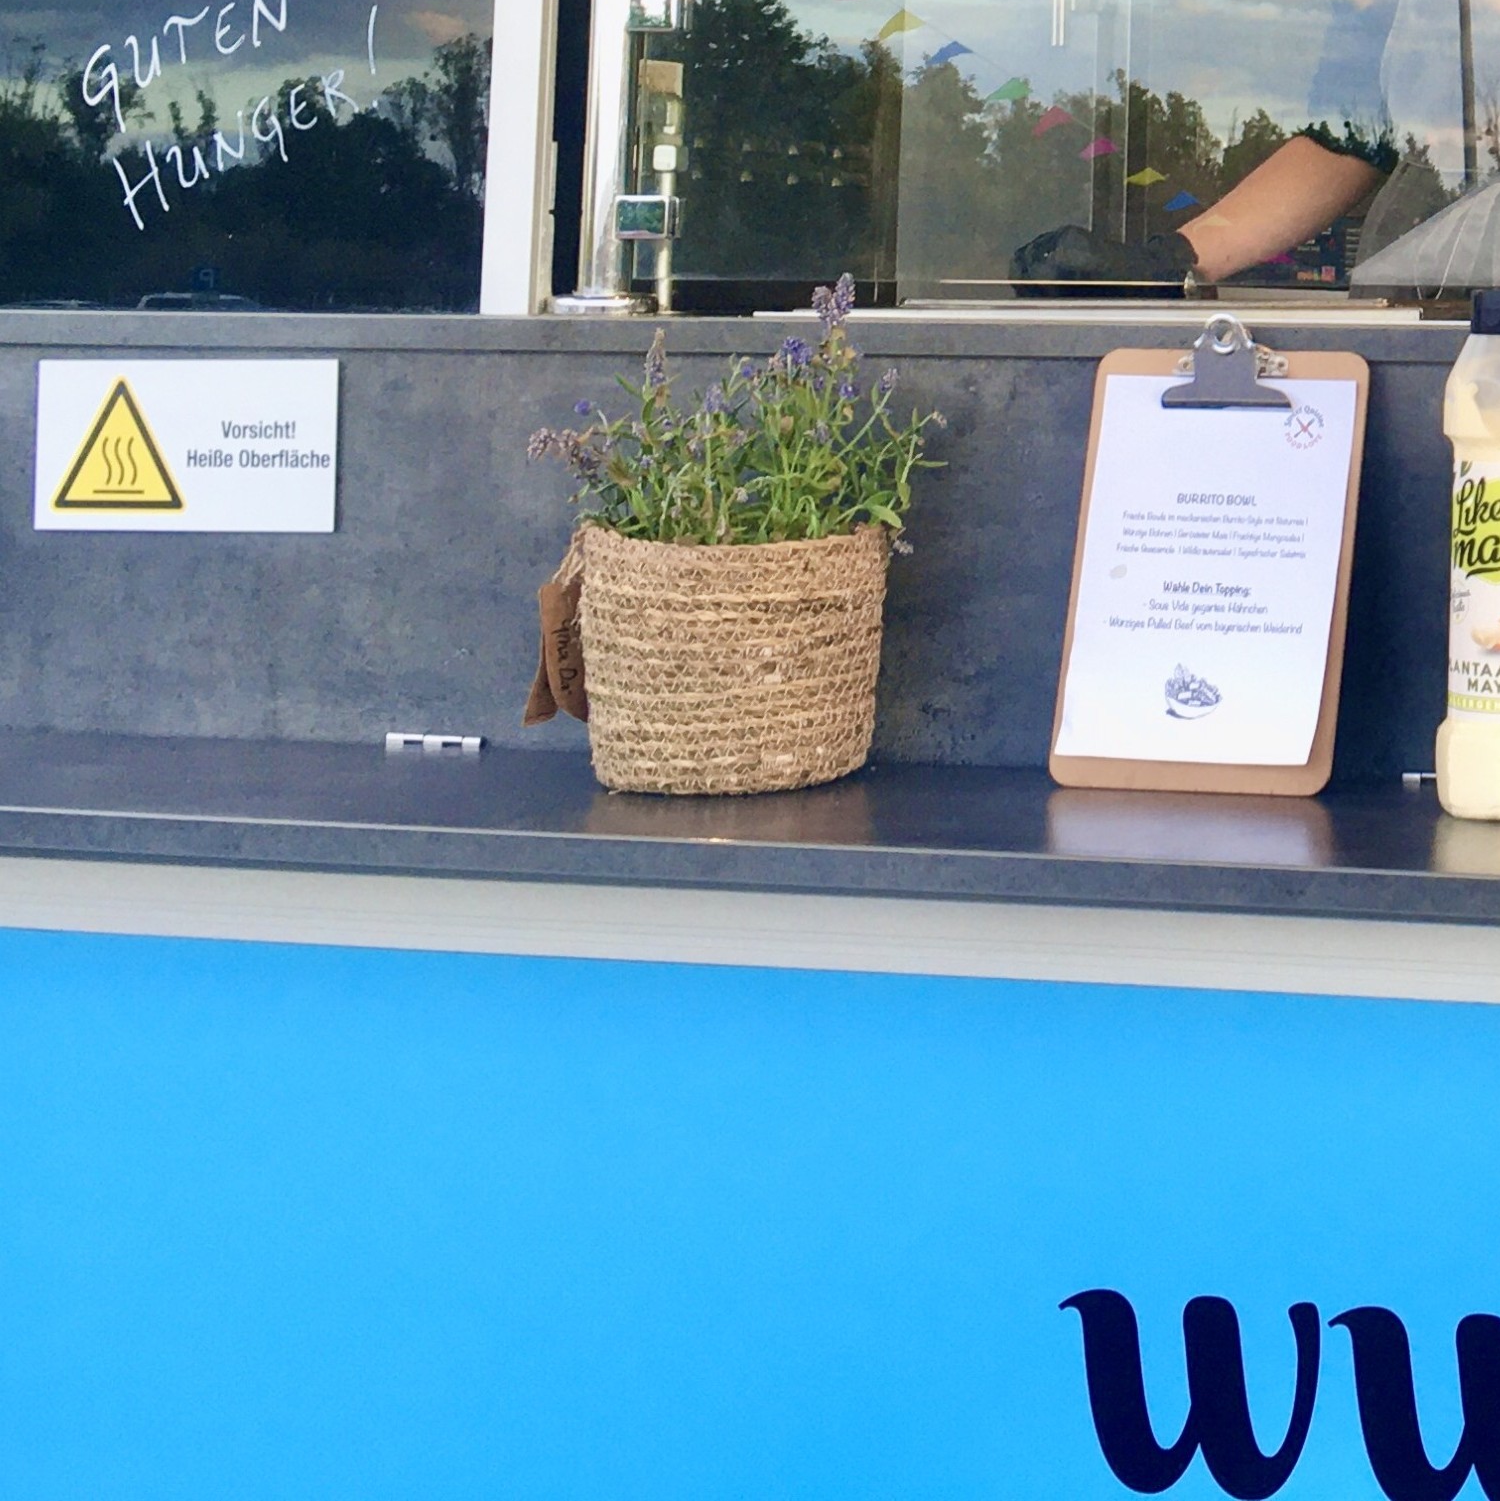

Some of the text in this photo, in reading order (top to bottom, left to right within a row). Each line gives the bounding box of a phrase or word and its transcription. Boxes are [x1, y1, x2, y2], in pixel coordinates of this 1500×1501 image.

[221, 420, 297, 440] Vorsicht!
[186, 449, 331, 469] Heiße Oberfläche
[1177, 493, 1257, 507] BURRITO BOWL
[1192, 581, 1213, 594] Dein
